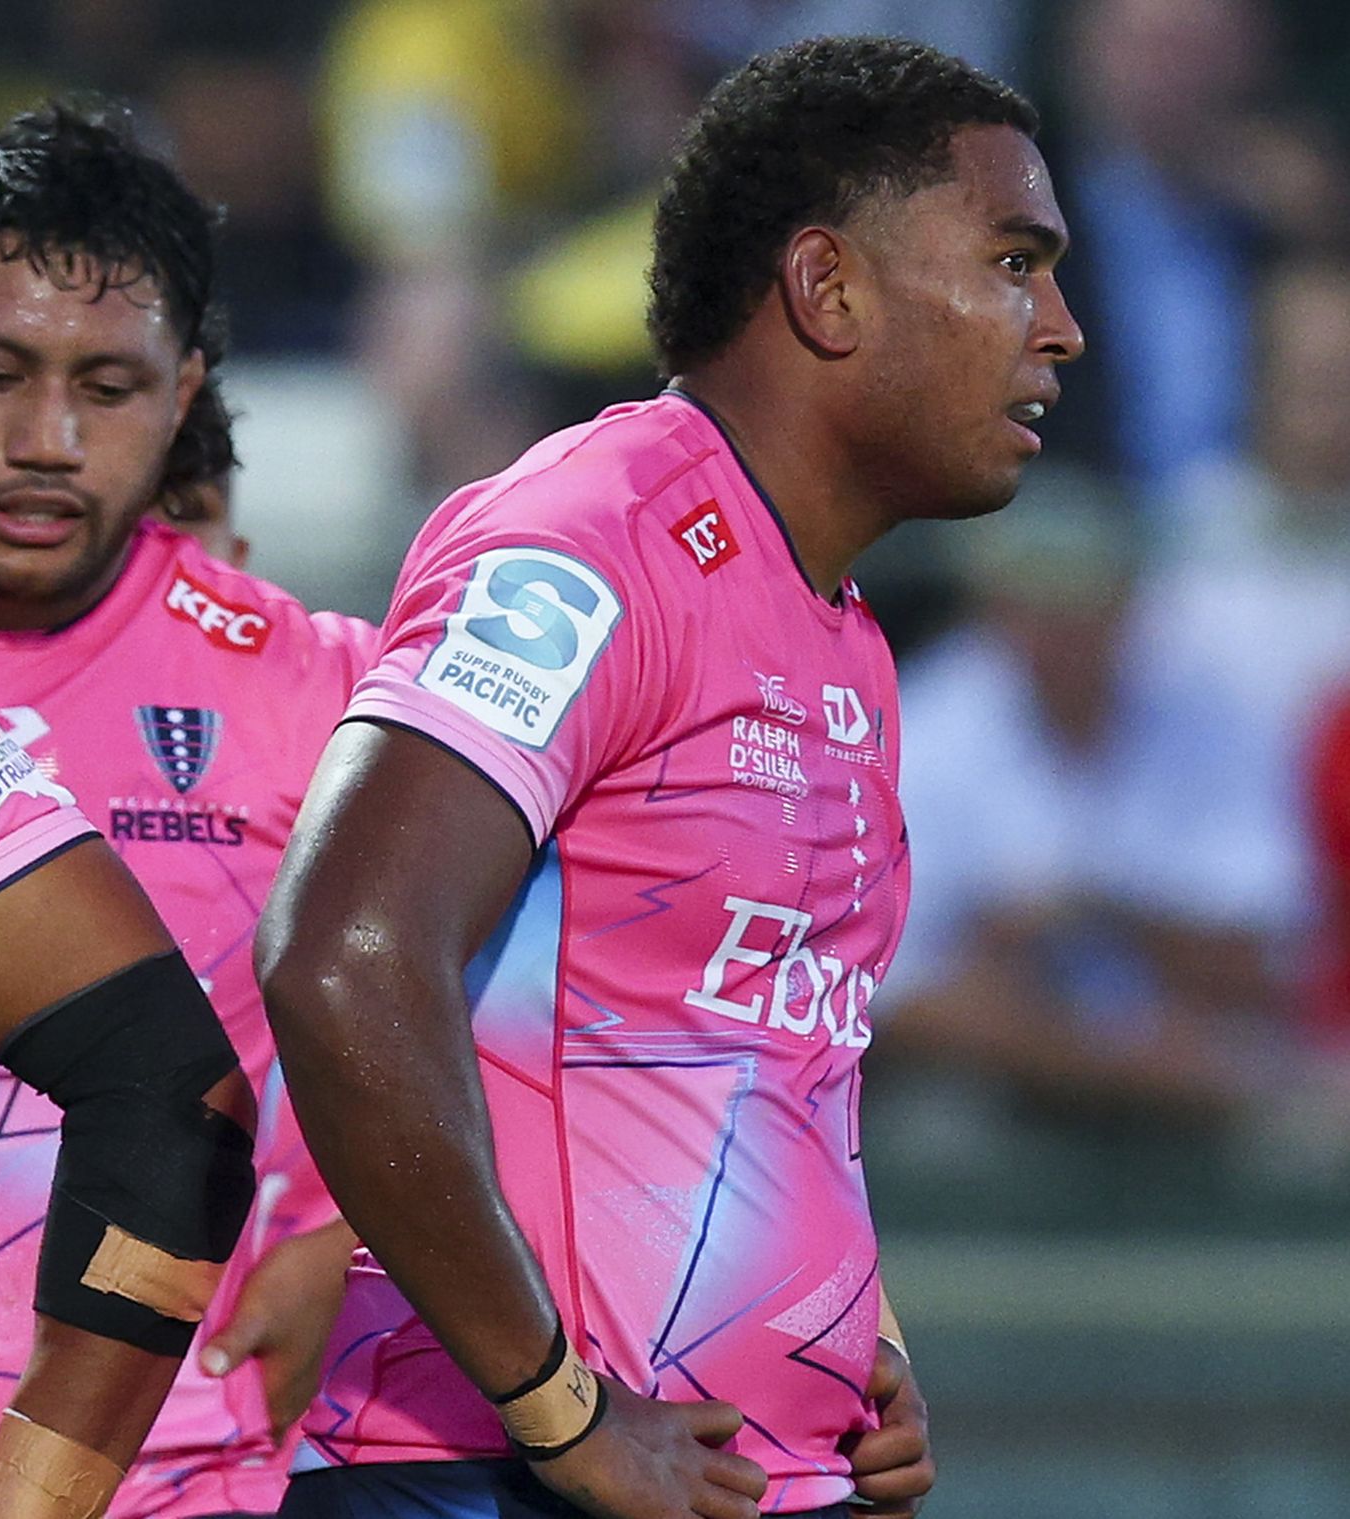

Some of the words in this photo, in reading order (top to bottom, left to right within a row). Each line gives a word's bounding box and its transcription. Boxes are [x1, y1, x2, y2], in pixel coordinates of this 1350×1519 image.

[166, 578, 266, 647] KFC
[438, 663, 542, 729] PACIFIC
[452, 650, 501, 675] SUPER
[502, 667, 552, 705] RUGBY
[732, 714, 801, 758] RALPH
[111, 808, 248, 846] REBELS
